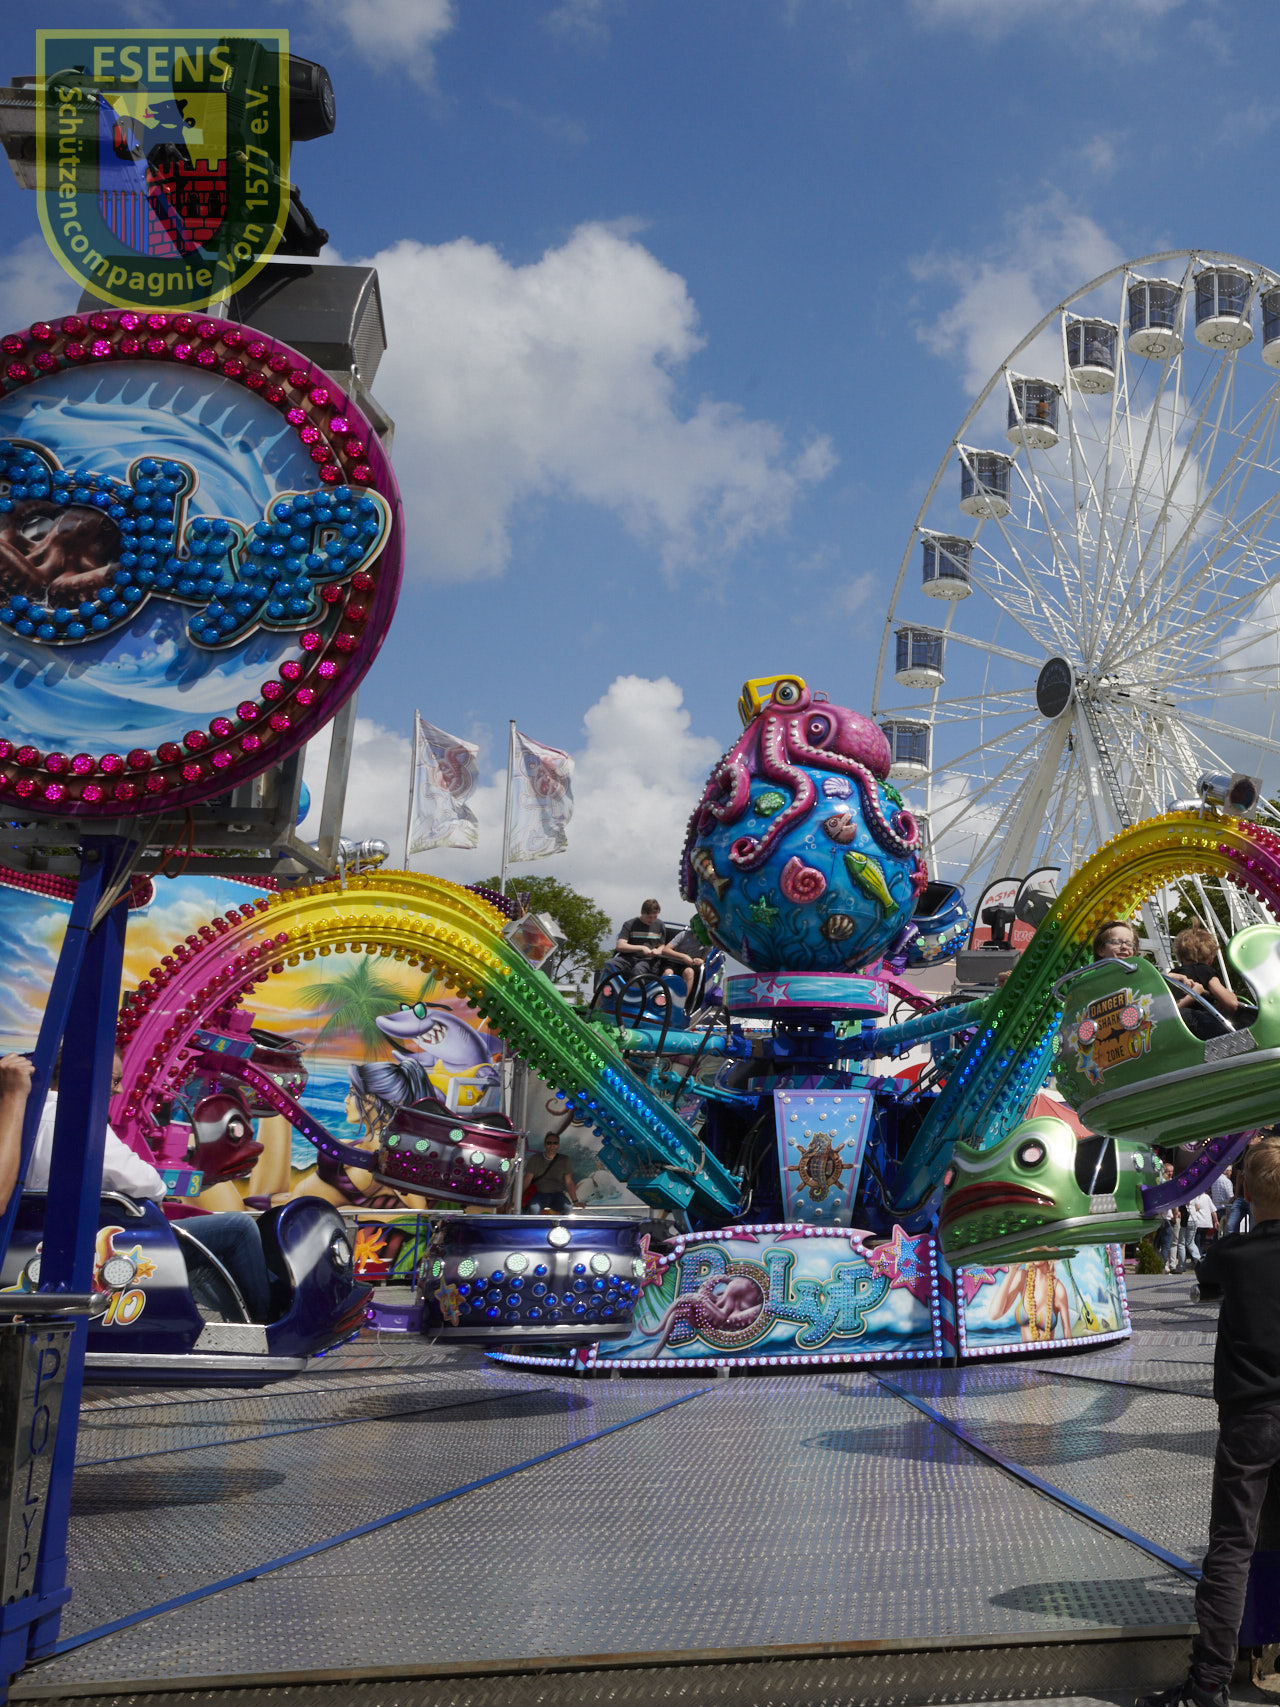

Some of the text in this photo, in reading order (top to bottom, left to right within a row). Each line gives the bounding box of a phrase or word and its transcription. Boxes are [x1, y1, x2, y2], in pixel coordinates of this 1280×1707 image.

[985, 888, 1017, 905] ASIA
[1090, 994, 1125, 1017] DANGER
[215, 1039, 226, 1053] 4
[1106, 1045, 1126, 1063] ZONE
[189, 1174, 200, 1195] 3
[103, 1289, 147, 1327] 10
[17, 1346, 61, 1590] POLYP
